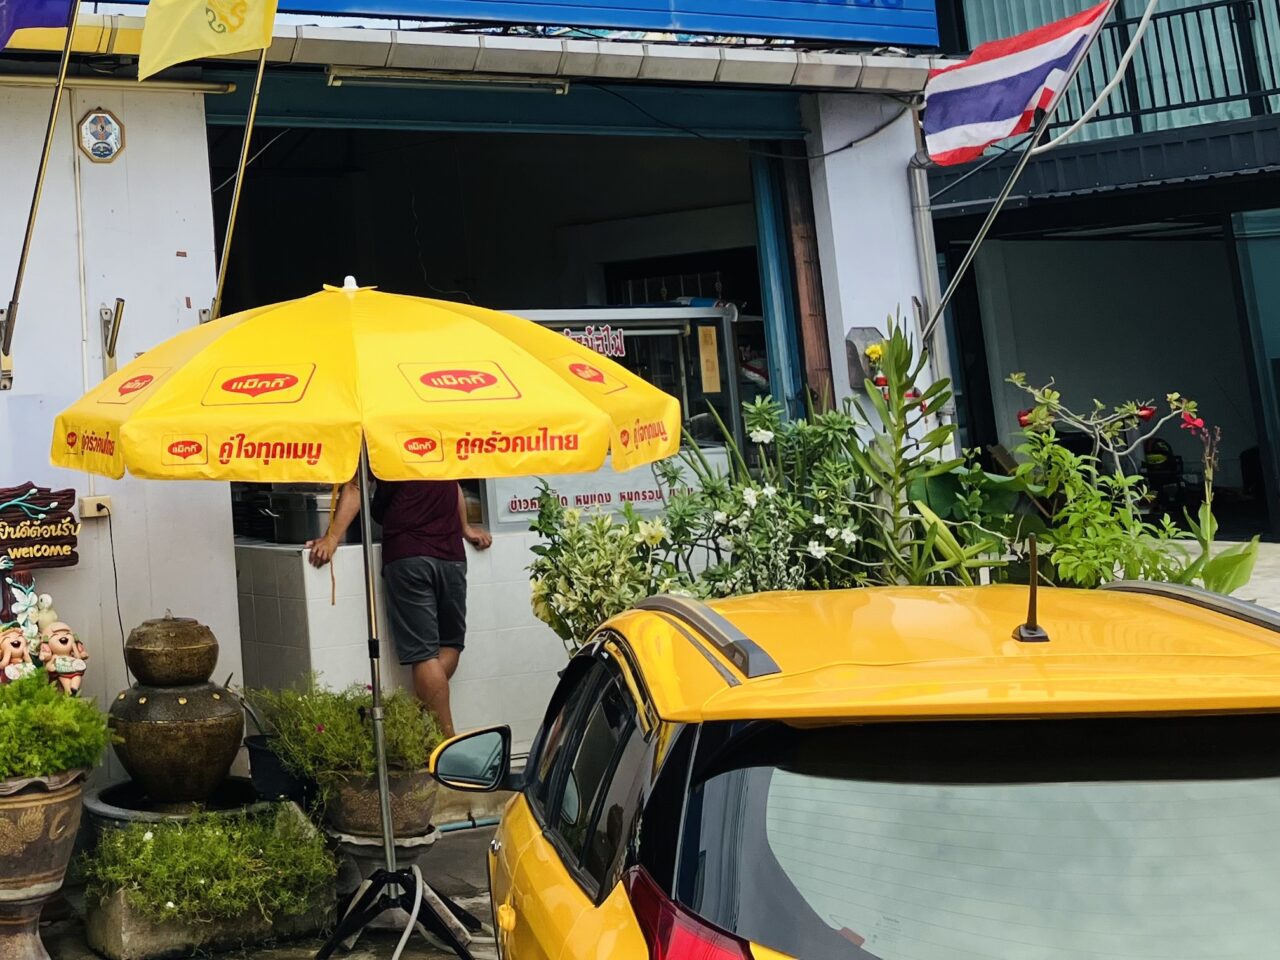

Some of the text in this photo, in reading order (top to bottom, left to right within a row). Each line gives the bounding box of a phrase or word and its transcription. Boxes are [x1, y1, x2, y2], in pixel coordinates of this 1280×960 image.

[219, 433, 322, 465] คู่ใจทุกเมนู
[456, 427, 578, 460] คู่ครัวคนไทย
